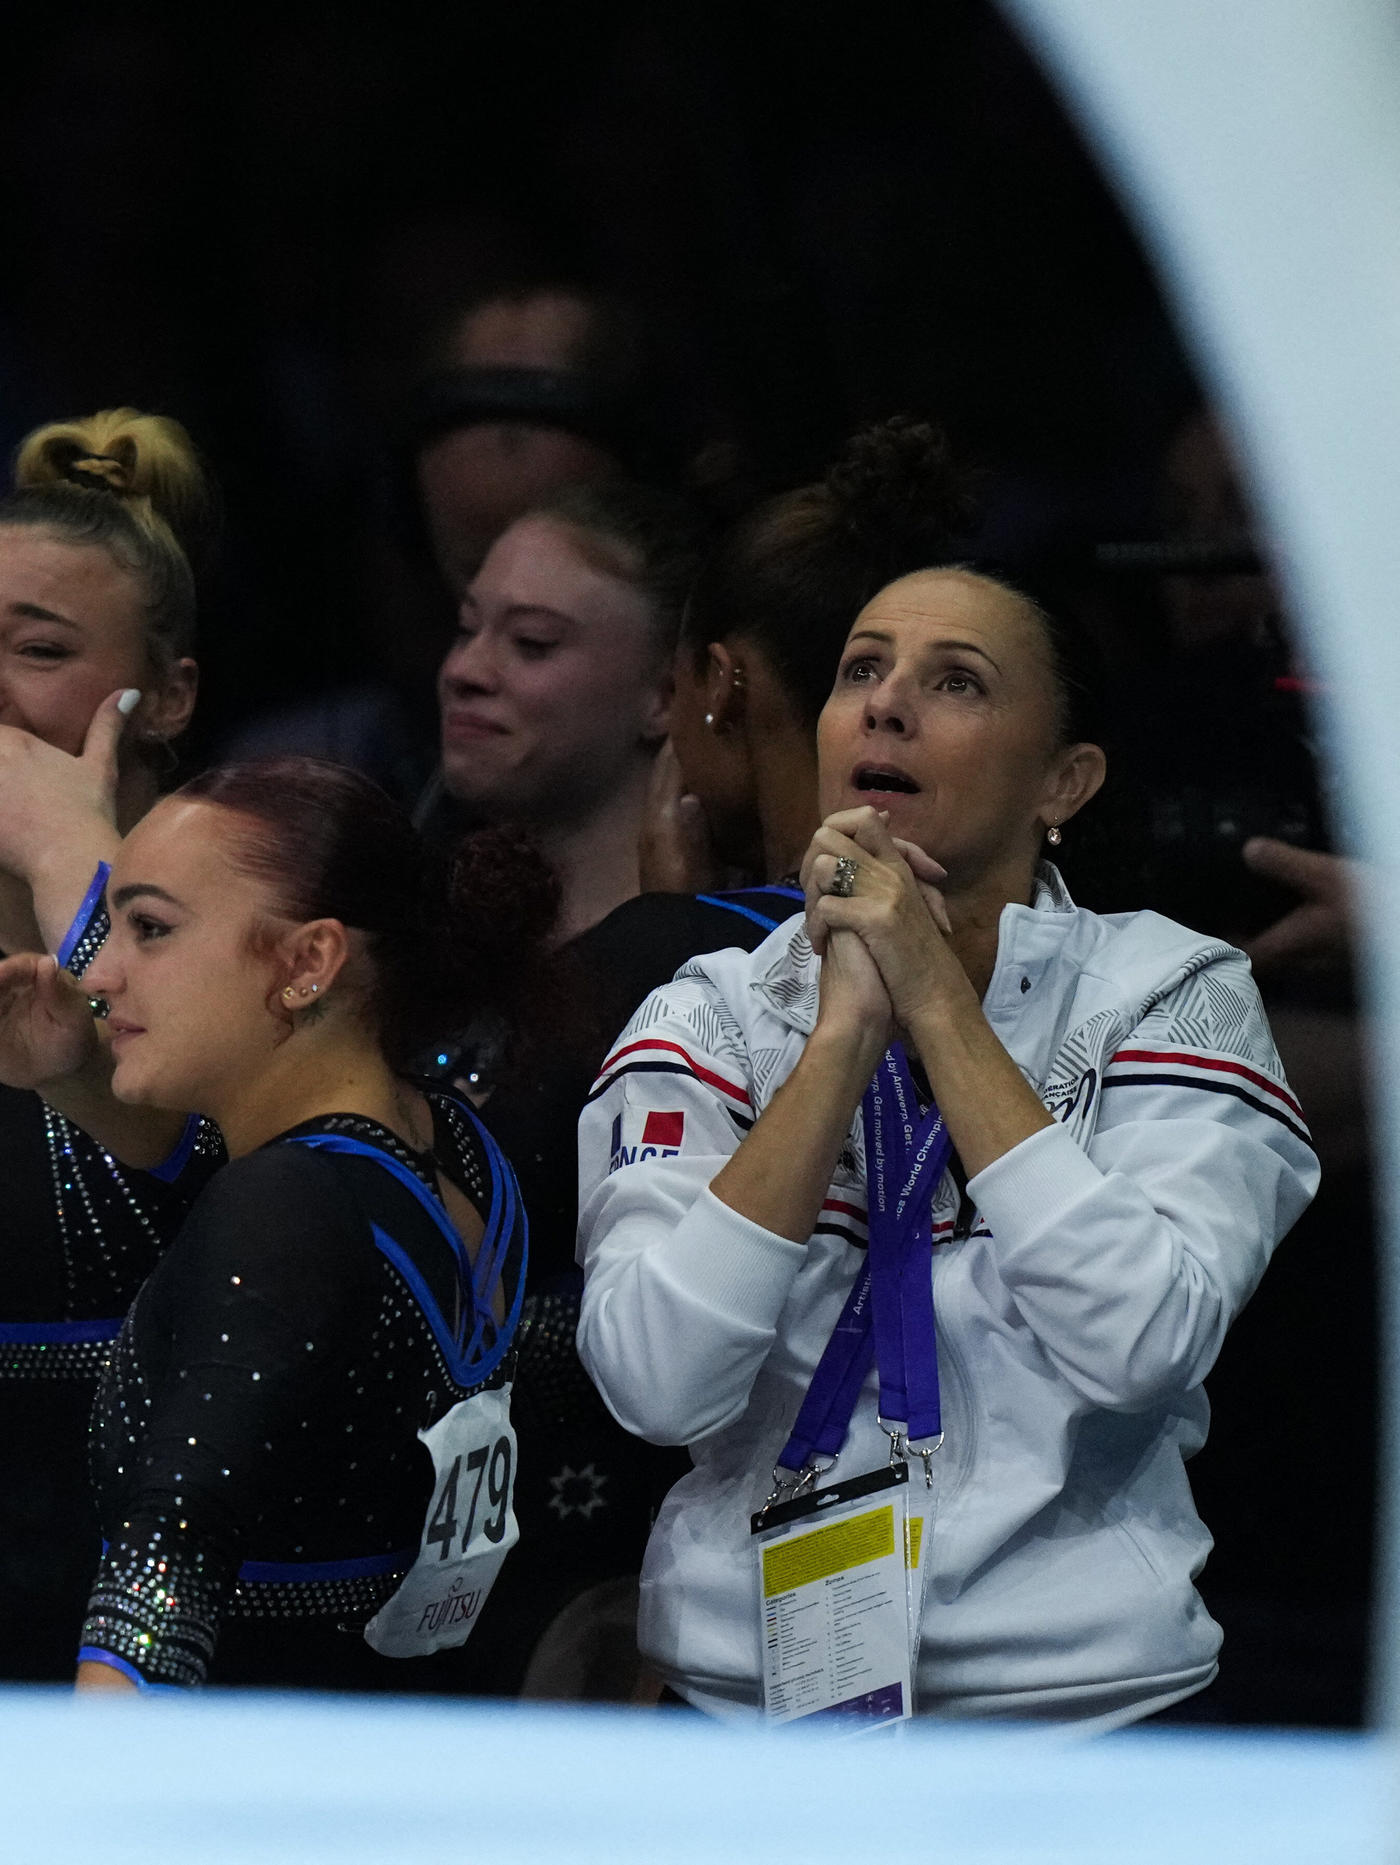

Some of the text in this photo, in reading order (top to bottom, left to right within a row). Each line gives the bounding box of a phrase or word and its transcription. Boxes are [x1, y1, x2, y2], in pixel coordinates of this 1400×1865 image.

[877, 1173, 887, 1212] motion
[900, 1163, 923, 1196] World
[426, 1435, 511, 1561] 479
[416, 1589, 481, 1633] FUJITSU
